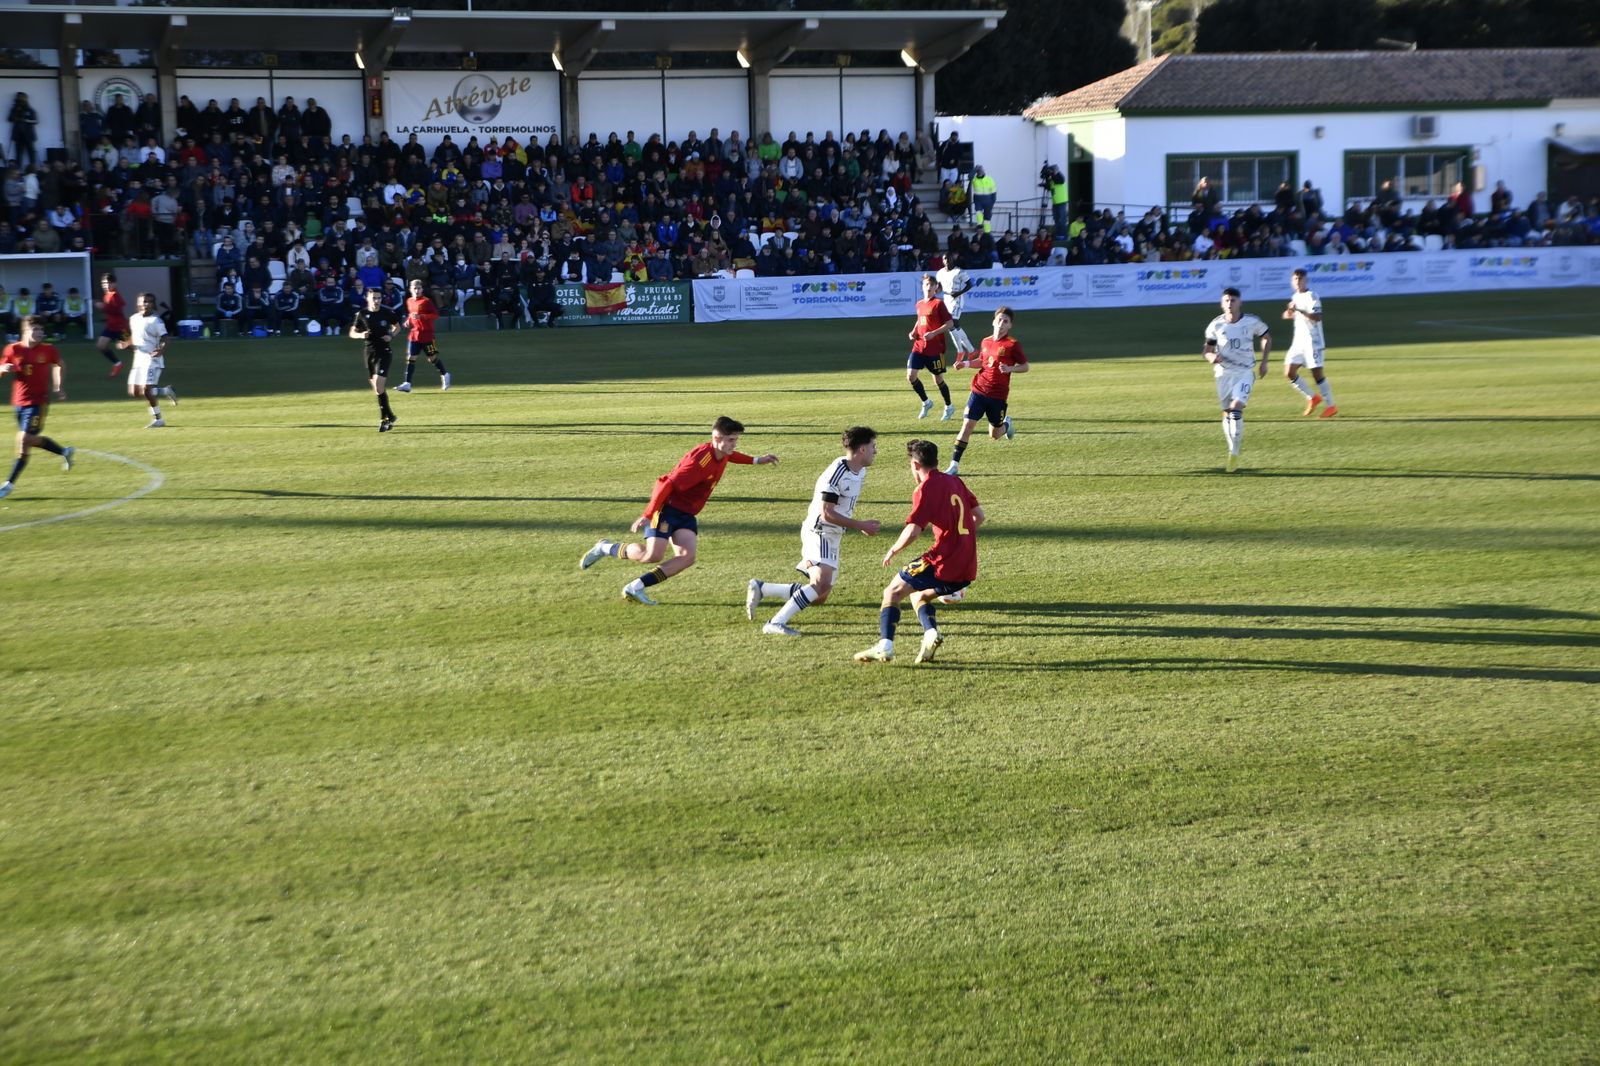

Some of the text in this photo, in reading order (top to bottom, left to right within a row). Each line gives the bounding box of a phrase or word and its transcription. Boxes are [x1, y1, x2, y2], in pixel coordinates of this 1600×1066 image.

[422, 75, 532, 121] Atrévete
[478, 125, 557, 133] TORREMOLINOS
[644, 286, 676, 294] FRUTAS
[966, 288, 1039, 299] TORREMOLINOS
[792, 294, 866, 304] TORREMOLINOS
[1229, 338, 1241, 349] 10
[1241, 382, 1251, 394] 10
[950, 493, 970, 535] 2
